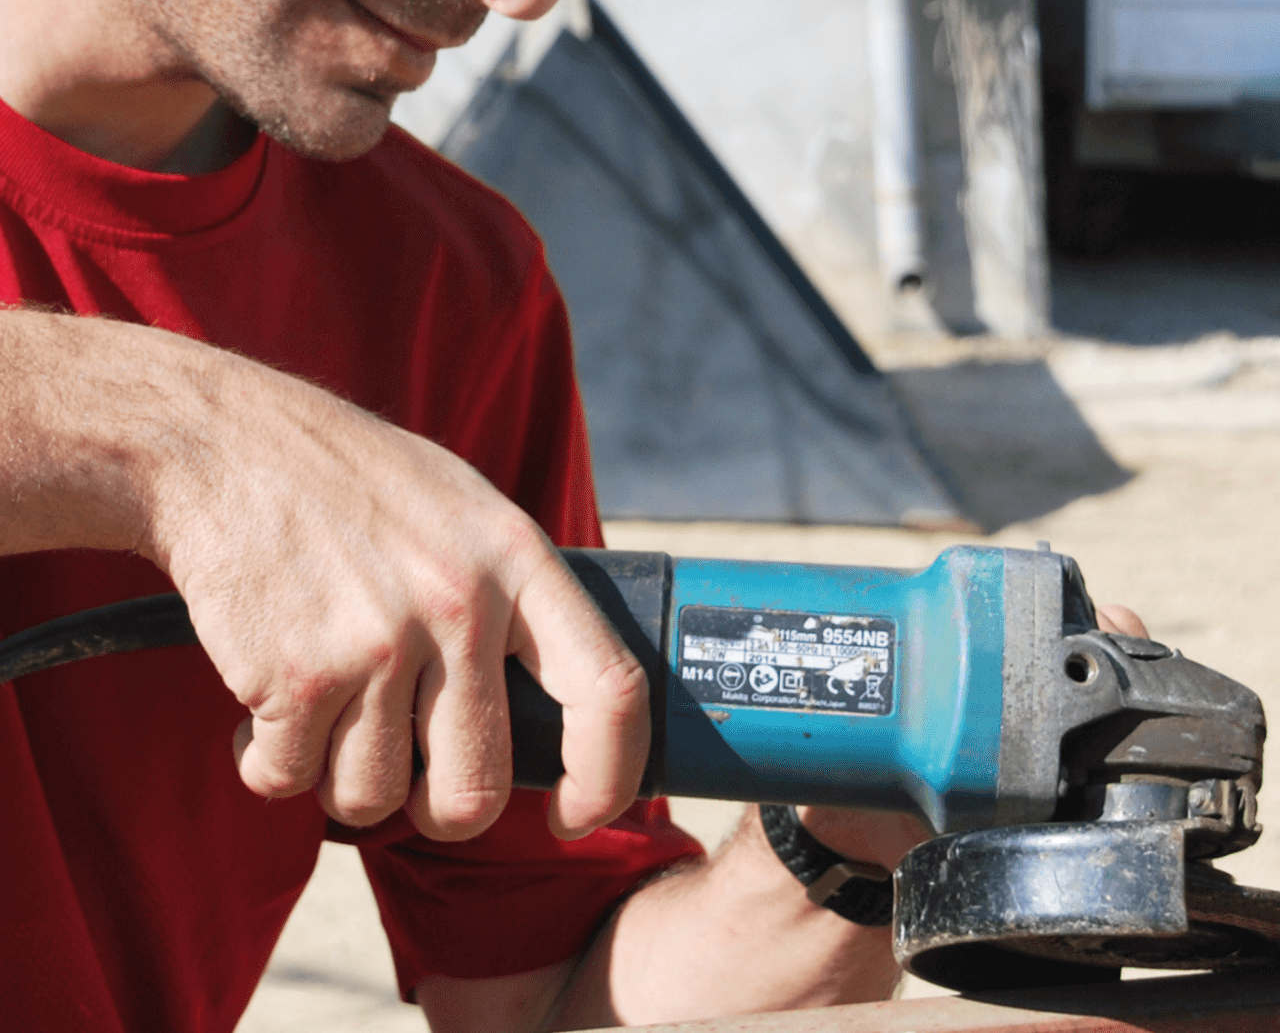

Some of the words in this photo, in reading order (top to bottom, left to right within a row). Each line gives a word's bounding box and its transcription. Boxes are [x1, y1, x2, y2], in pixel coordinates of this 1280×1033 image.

[823, 627, 889, 647] 9554NB
[749, 654, 777, 664] 2014
[681, 666, 714, 682] M14
